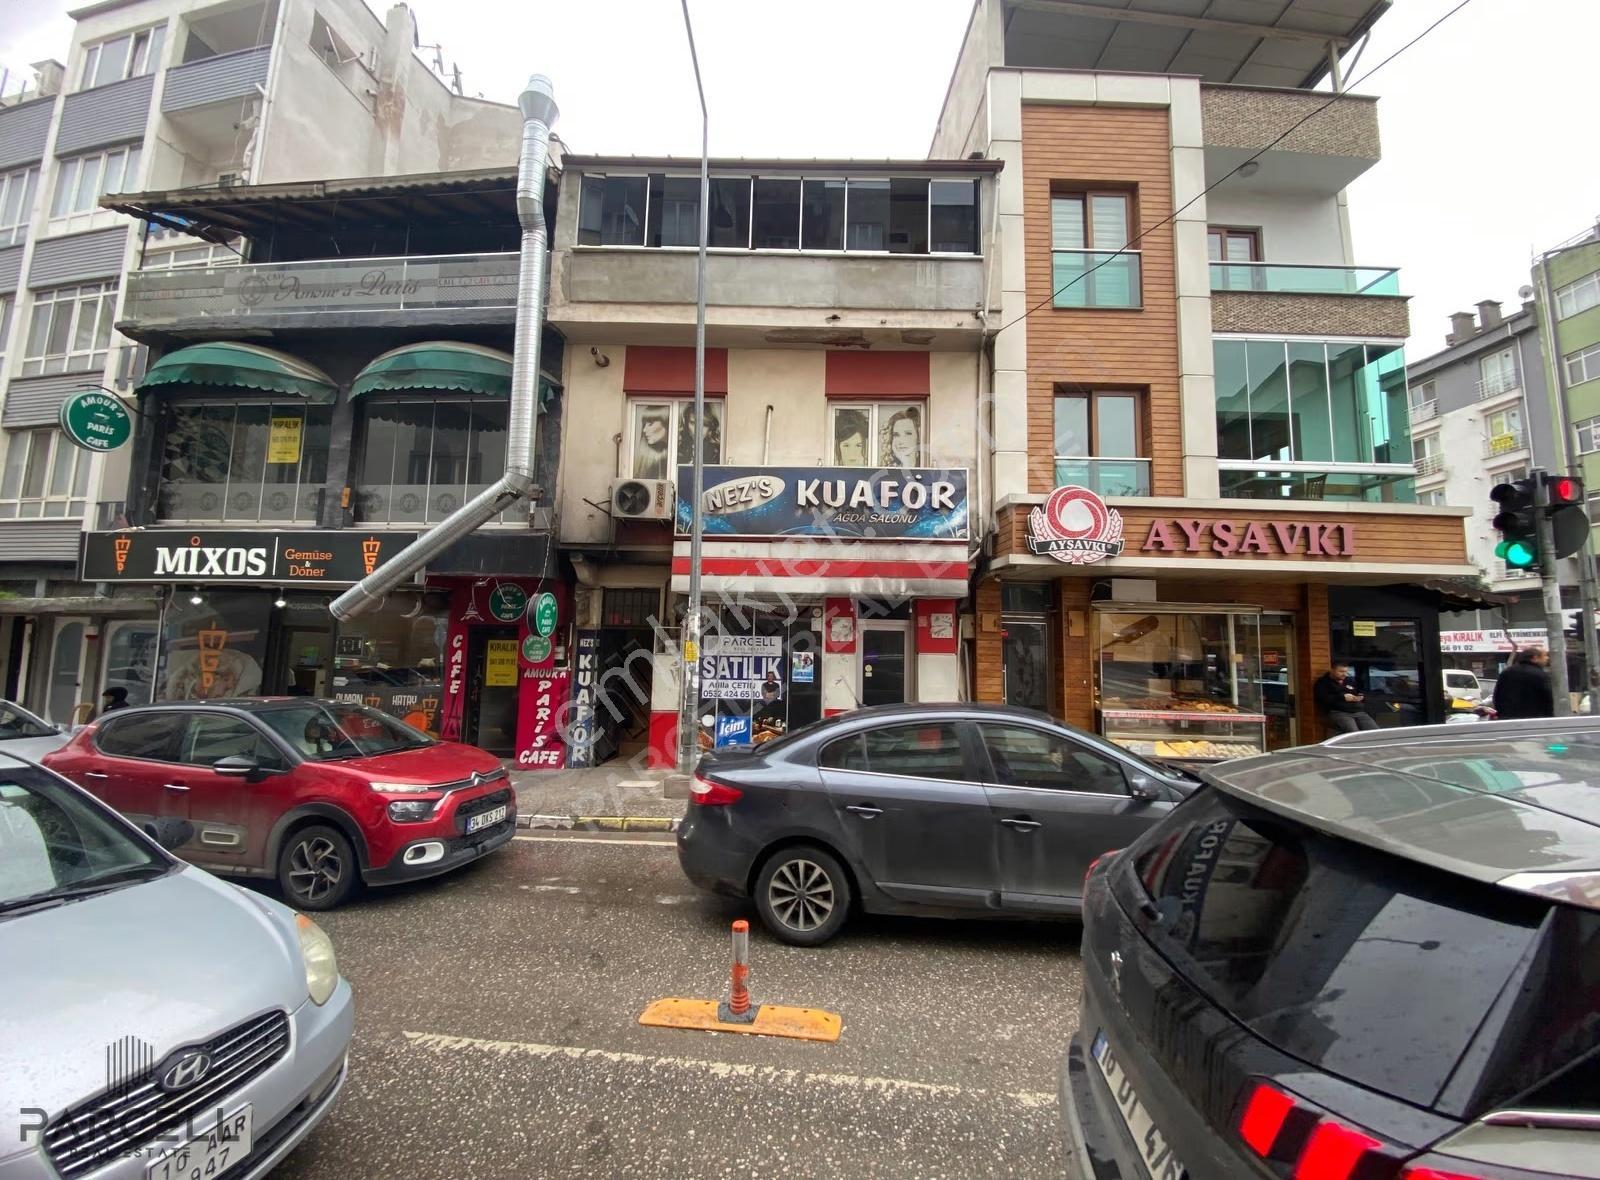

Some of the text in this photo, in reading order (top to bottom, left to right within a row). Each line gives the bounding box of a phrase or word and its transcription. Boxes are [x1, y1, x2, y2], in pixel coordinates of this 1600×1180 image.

[355, 269, 420, 296] Paris
[86, 436, 109, 448] CAFE
[706, 473, 957, 512] NEZ'S KUAFÖR
[868, 512, 918, 524] SALONU
[1142, 518, 1357, 558] AYŞAVKI
[285, 548, 333, 561] Gemüse
[289, 564, 326, 578] Döner
[304, 560, 312, 568] &
[723, 637, 776, 647] PARCELL
[449, 634, 463, 694] CAFE
[702, 656, 782, 680] SATILIK
[703, 690, 723, 698] 0532
[723, 690, 738, 698] 424
[740, 690, 750, 698] 65
[572, 654, 592, 762] KUAFÖR
[519, 750, 560, 765] CAFE
[471, 817, 480, 829] 34
[162, 1115, 247, 1180] 10 AAR
